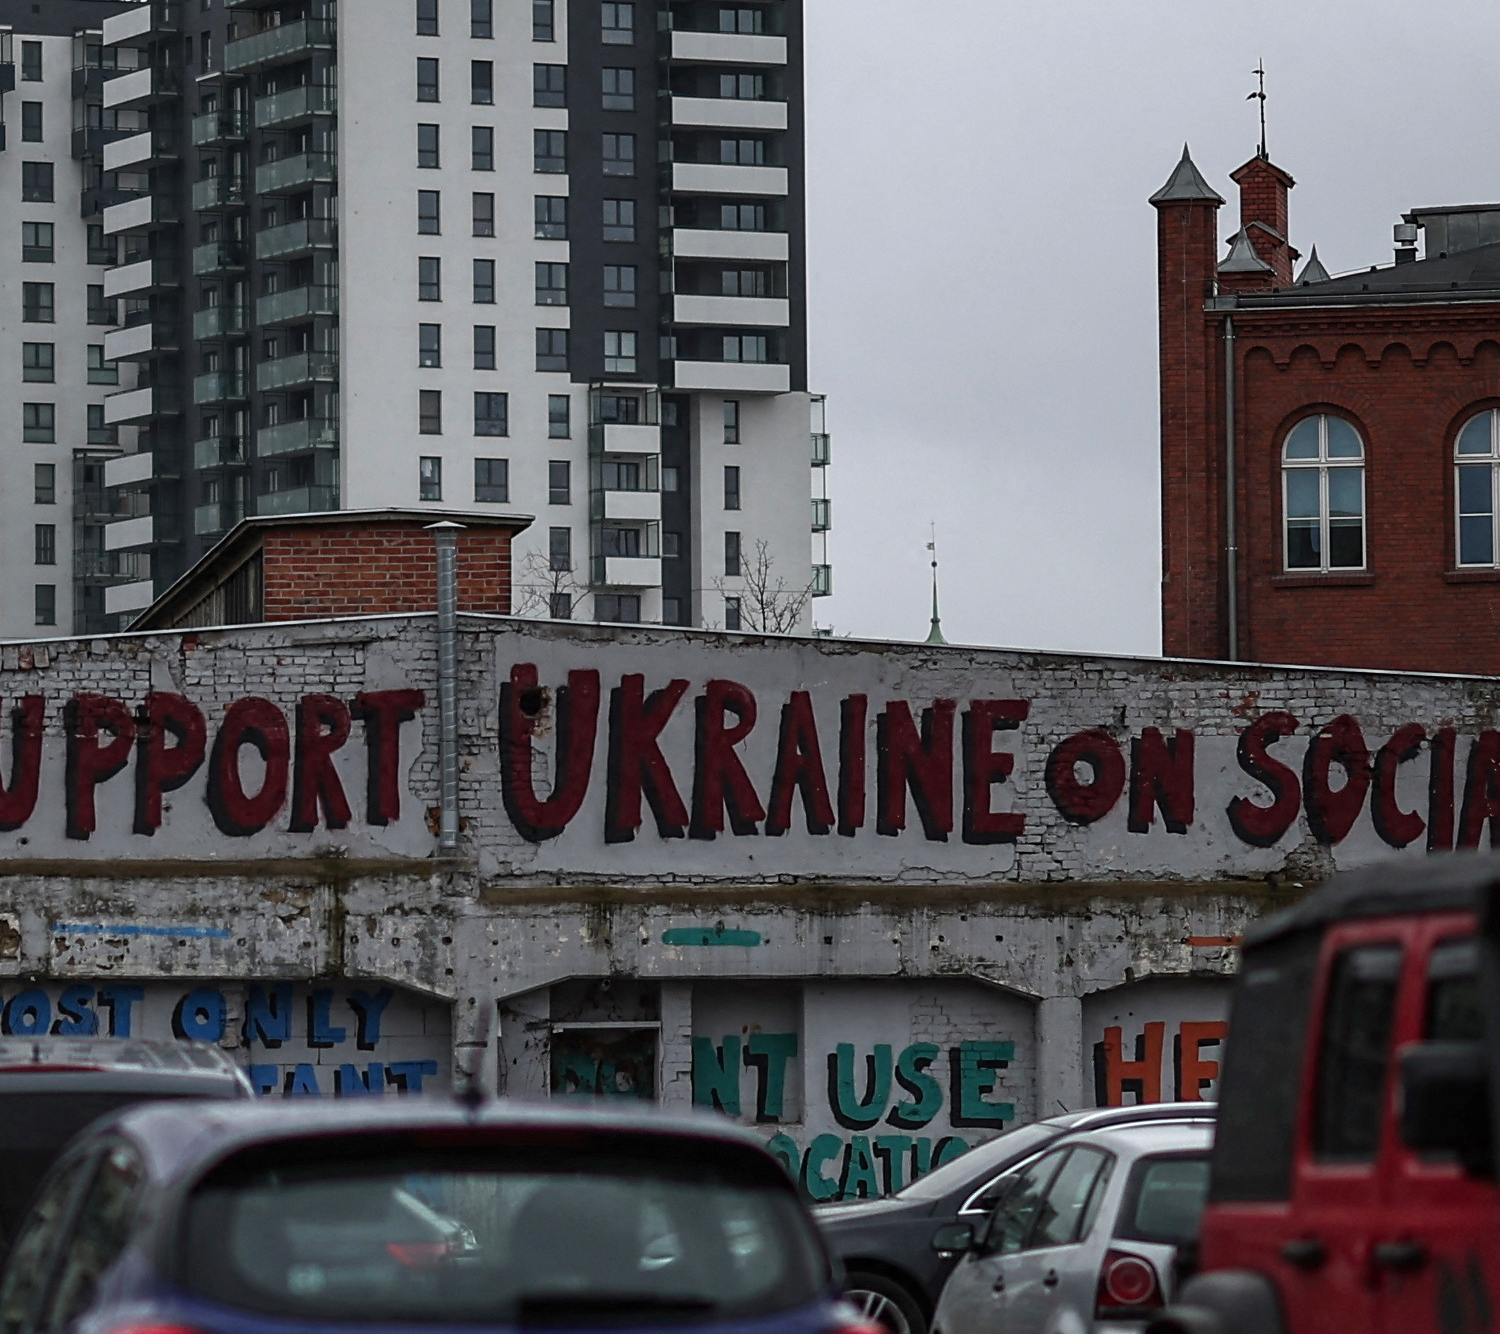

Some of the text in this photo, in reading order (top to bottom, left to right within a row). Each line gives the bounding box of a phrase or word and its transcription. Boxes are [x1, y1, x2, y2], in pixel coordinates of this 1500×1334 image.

[498, 663, 1031, 845] UKRAINE
[1046, 726, 1195, 835] ON
[171, 983, 395, 1050] ONLY
[826, 1040, 1015, 1132] USE
